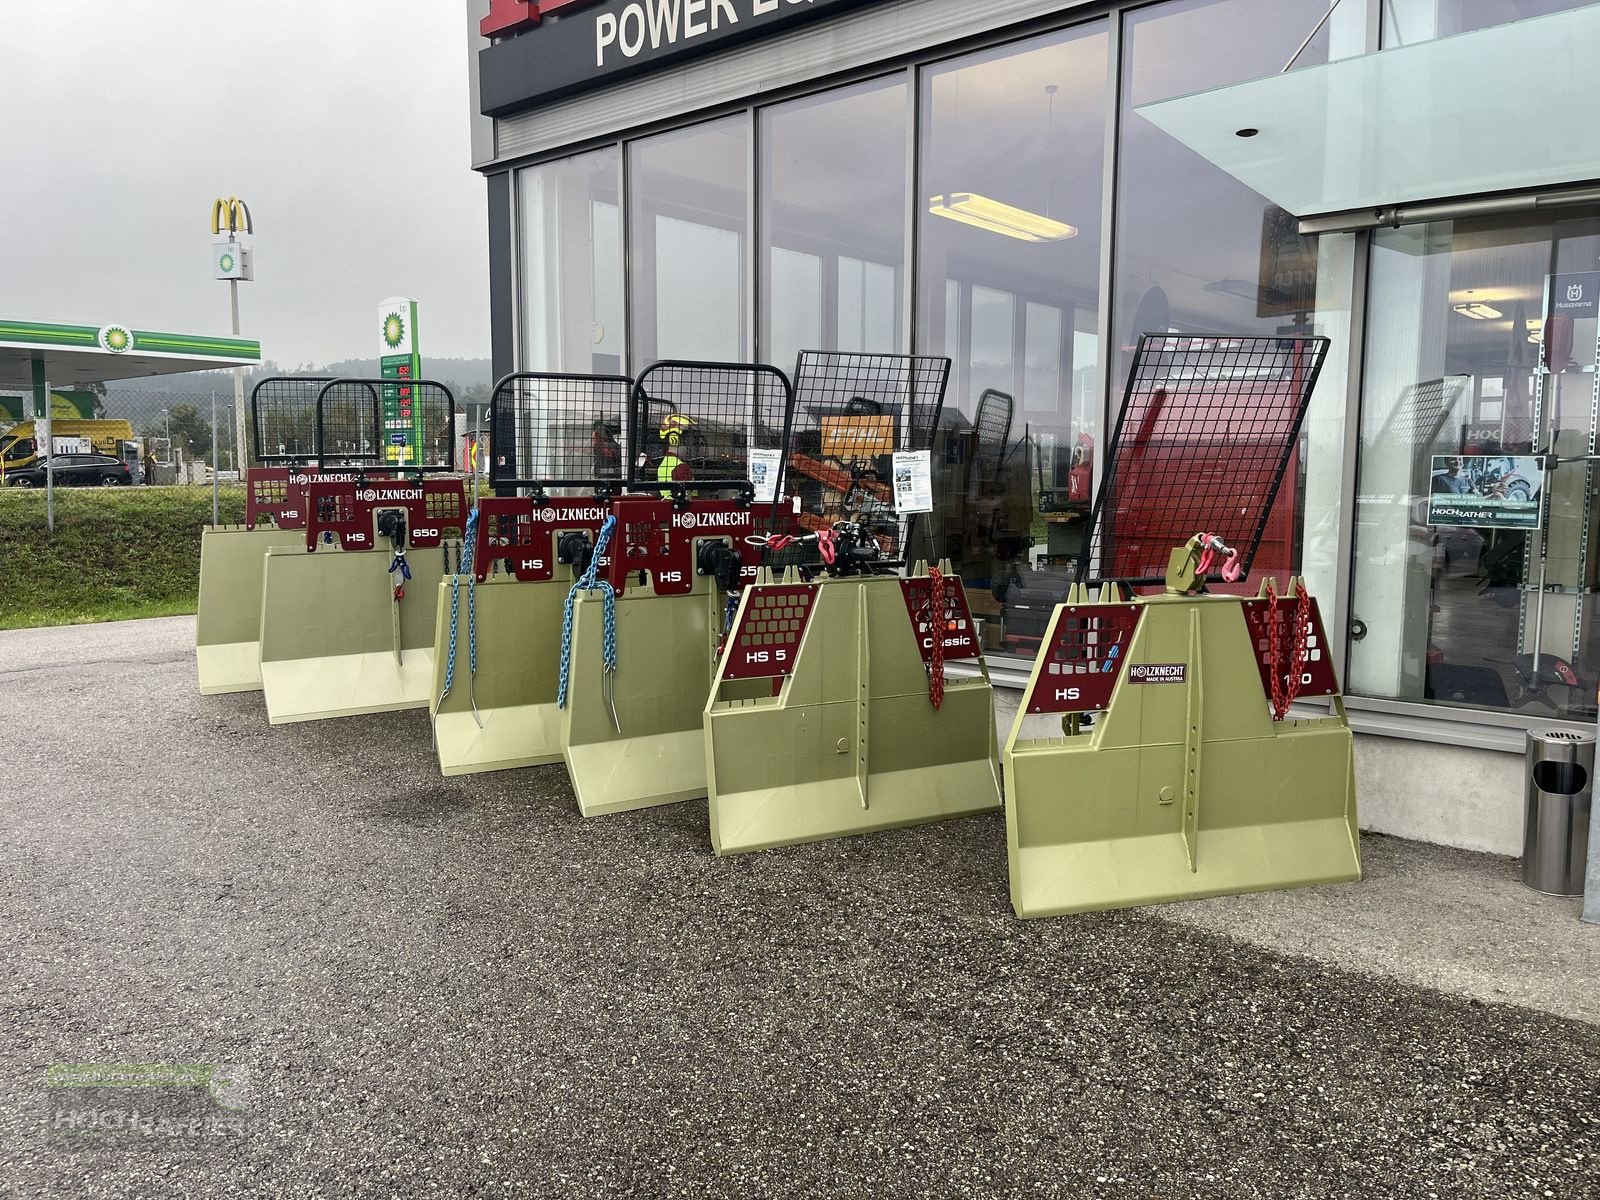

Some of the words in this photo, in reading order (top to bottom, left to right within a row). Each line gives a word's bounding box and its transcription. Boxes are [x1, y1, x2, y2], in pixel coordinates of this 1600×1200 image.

[596, 0, 739, 67] POWER
[1555, 301, 1592, 309] Husqvarna
[828, 426, 886, 443] STIHL
[289, 474, 352, 485] HOLZKNECHT
[356, 489, 424, 502] HOLZKNECHT
[281, 511, 298, 519] HS
[1431, 508, 1493, 518] HOCHRATHER
[672, 512, 751, 528] HOLZKNECHT
[346, 533, 366, 542] HS
[413, 529, 438, 537] 650
[522, 559, 543, 569] HS
[660, 571, 682, 582] HS
[746, 652, 769, 663] HS
[775, 650, 787, 661] 5
[1130, 666, 1184, 678] HOLZKNECHT
[1055, 688, 1080, 700] HS
[1283, 673, 1312, 686] 10
